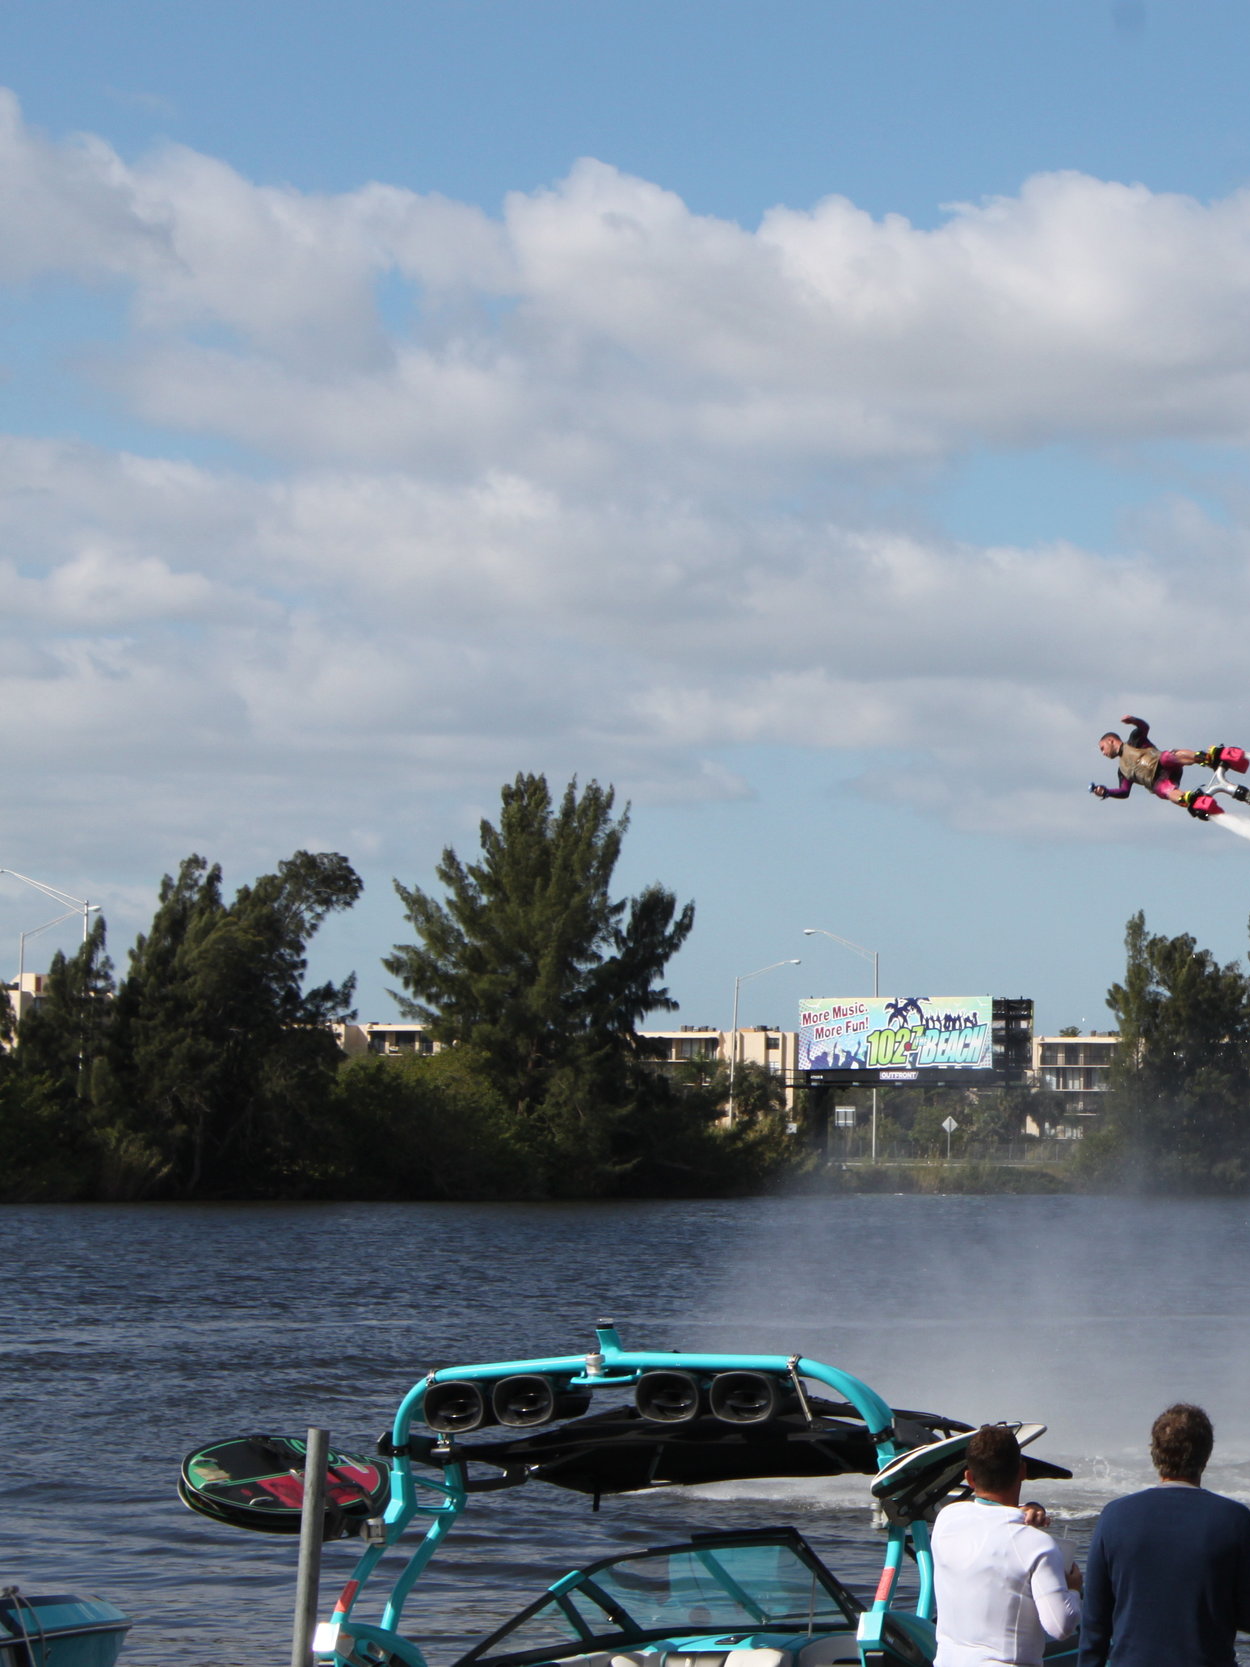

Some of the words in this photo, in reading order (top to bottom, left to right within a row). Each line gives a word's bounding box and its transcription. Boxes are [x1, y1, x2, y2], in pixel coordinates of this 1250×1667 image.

[802, 1011, 830, 1026] More
[832, 1001, 868, 1020] Music.
[815, 1025, 843, 1040] More
[845, 1016, 869, 1034] Fun!
[867, 1025, 925, 1066] 102.7
[919, 1023, 987, 1064] BEACH
